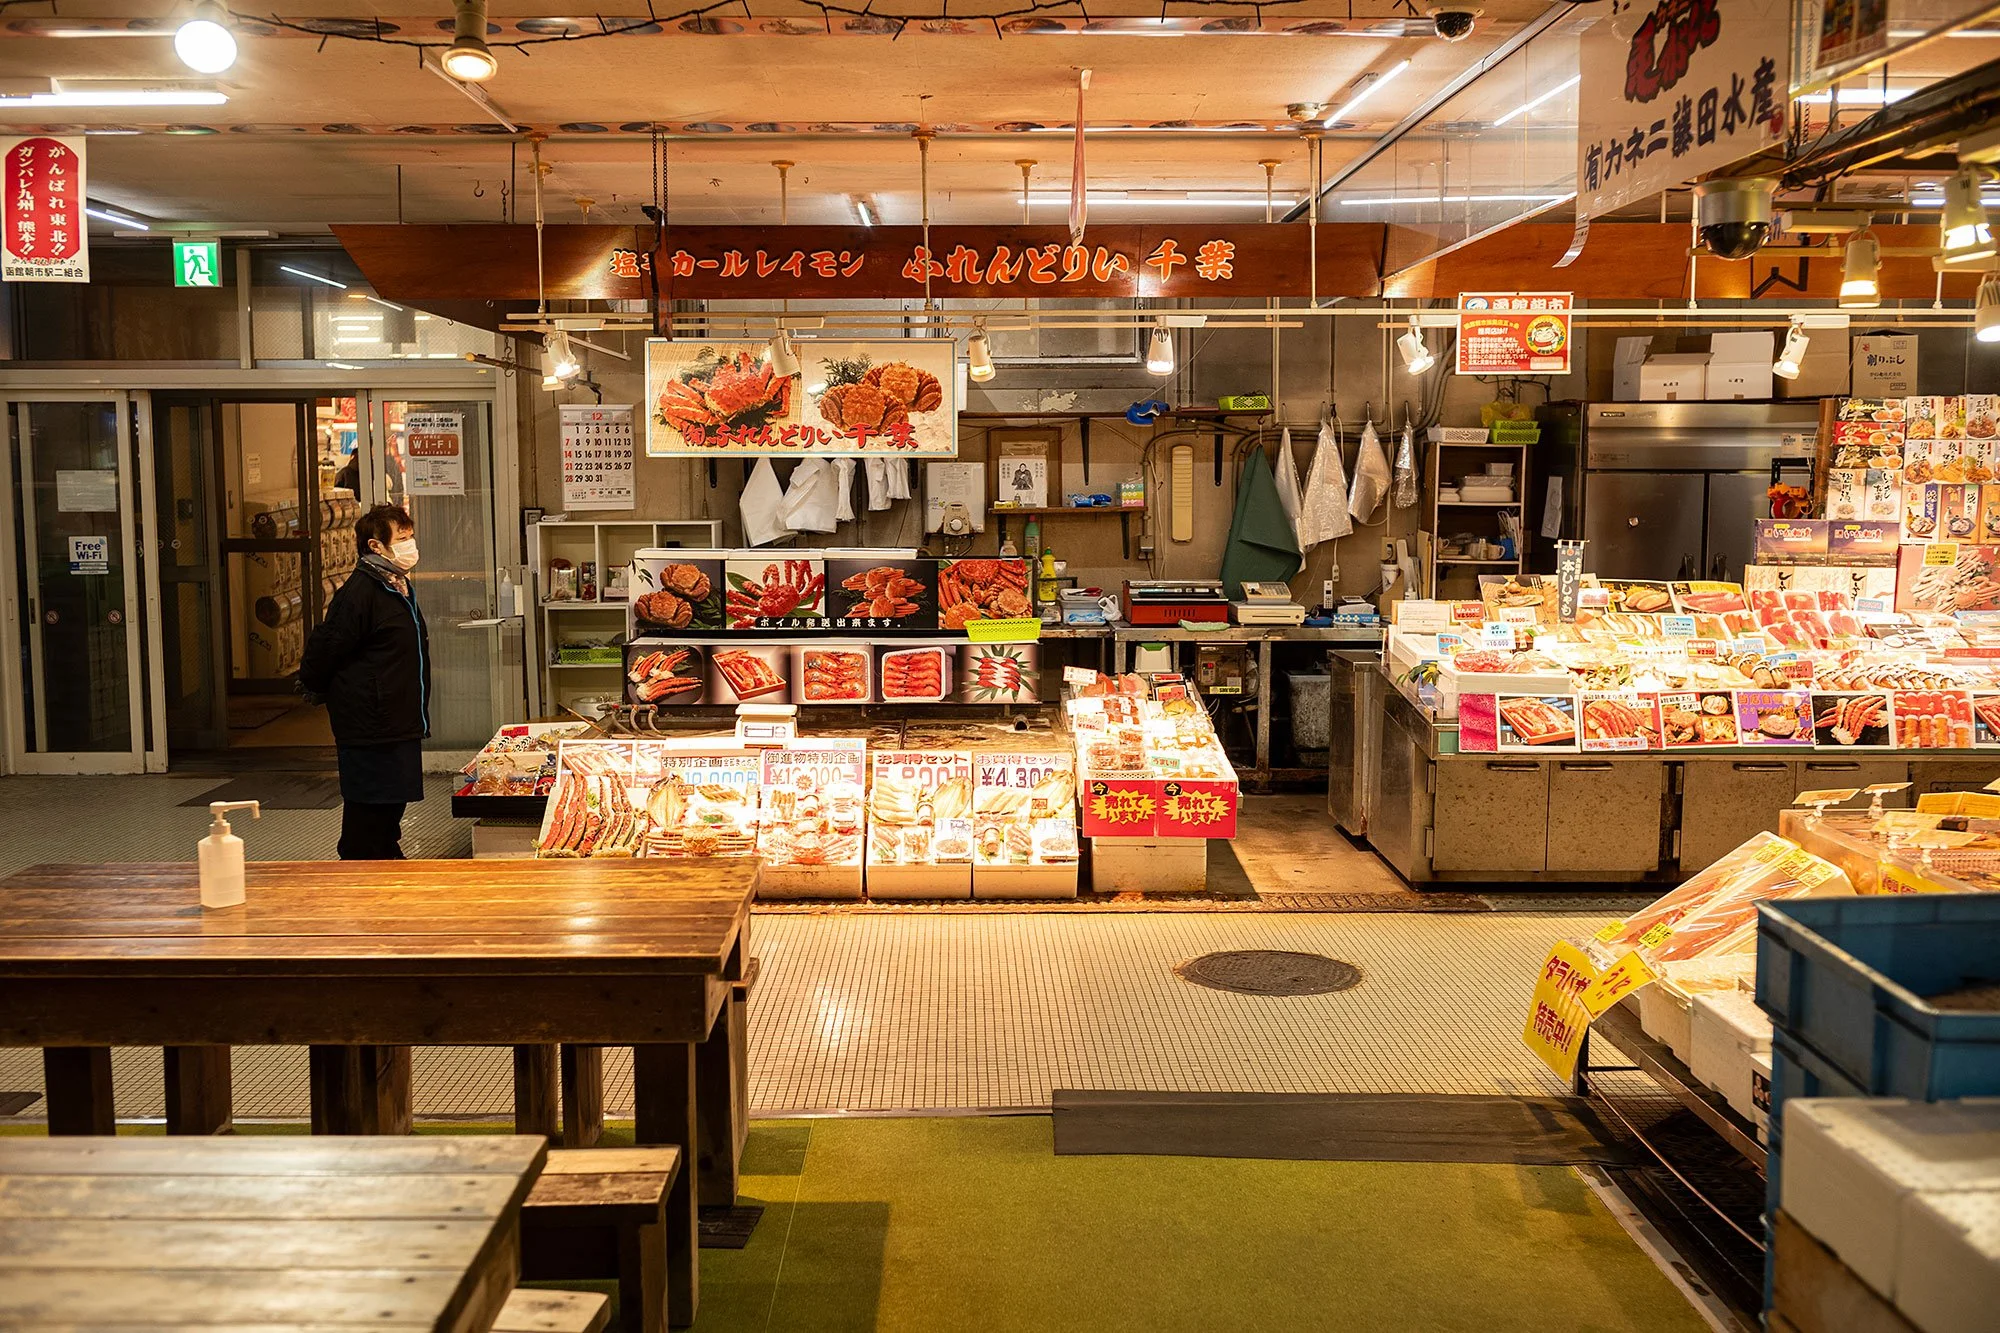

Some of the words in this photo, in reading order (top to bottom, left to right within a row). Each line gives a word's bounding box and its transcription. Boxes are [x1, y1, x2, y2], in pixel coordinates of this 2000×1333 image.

[48, 146, 68, 256] がんばれ東北!!
[672, 249, 865, 279] カールレイモン
[75, 541, 101, 551] Free
[76, 551, 102, 560] Wi-Fi
[1561, 560, 1575, 616] 本ししゃも
[760, 617, 902, 628] ボイル発送出来ます。
[662, 757, 722, 768] 特別企画
[877, 753, 968, 765] お買得セット
[977, 754, 1068, 765] お買得セット
[1093, 783, 1107, 795] 今
[1167, 783, 1181, 795] 今
[1105, 795, 1143, 810] 売れて
[1177, 796, 1215, 810] 売れて
[1106, 810, 1147, 822] います!
[1178, 810, 1220, 822] います!
